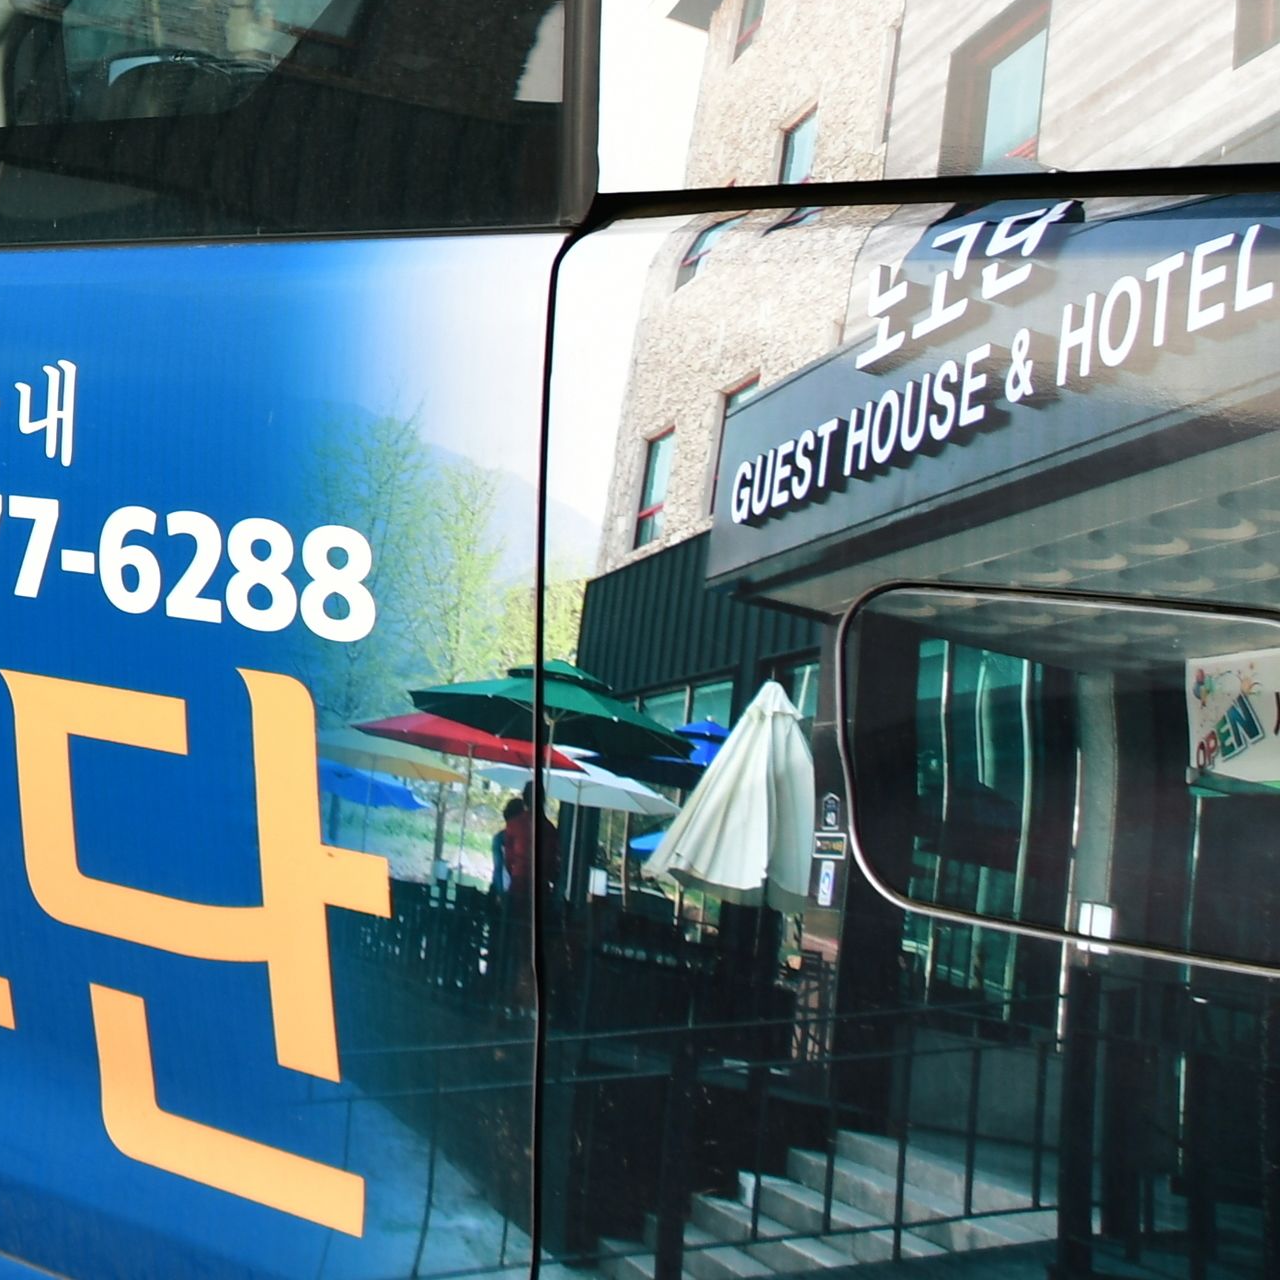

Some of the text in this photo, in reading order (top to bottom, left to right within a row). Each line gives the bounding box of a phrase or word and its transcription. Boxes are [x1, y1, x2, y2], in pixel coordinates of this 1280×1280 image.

[855, 200, 1078, 370] 노고단
[14, 357, 79, 468] 내
[731, 223, 1275, 524] GUEST HOUSE & HOTEL
[1197, 692, 1264, 774] OPEN
